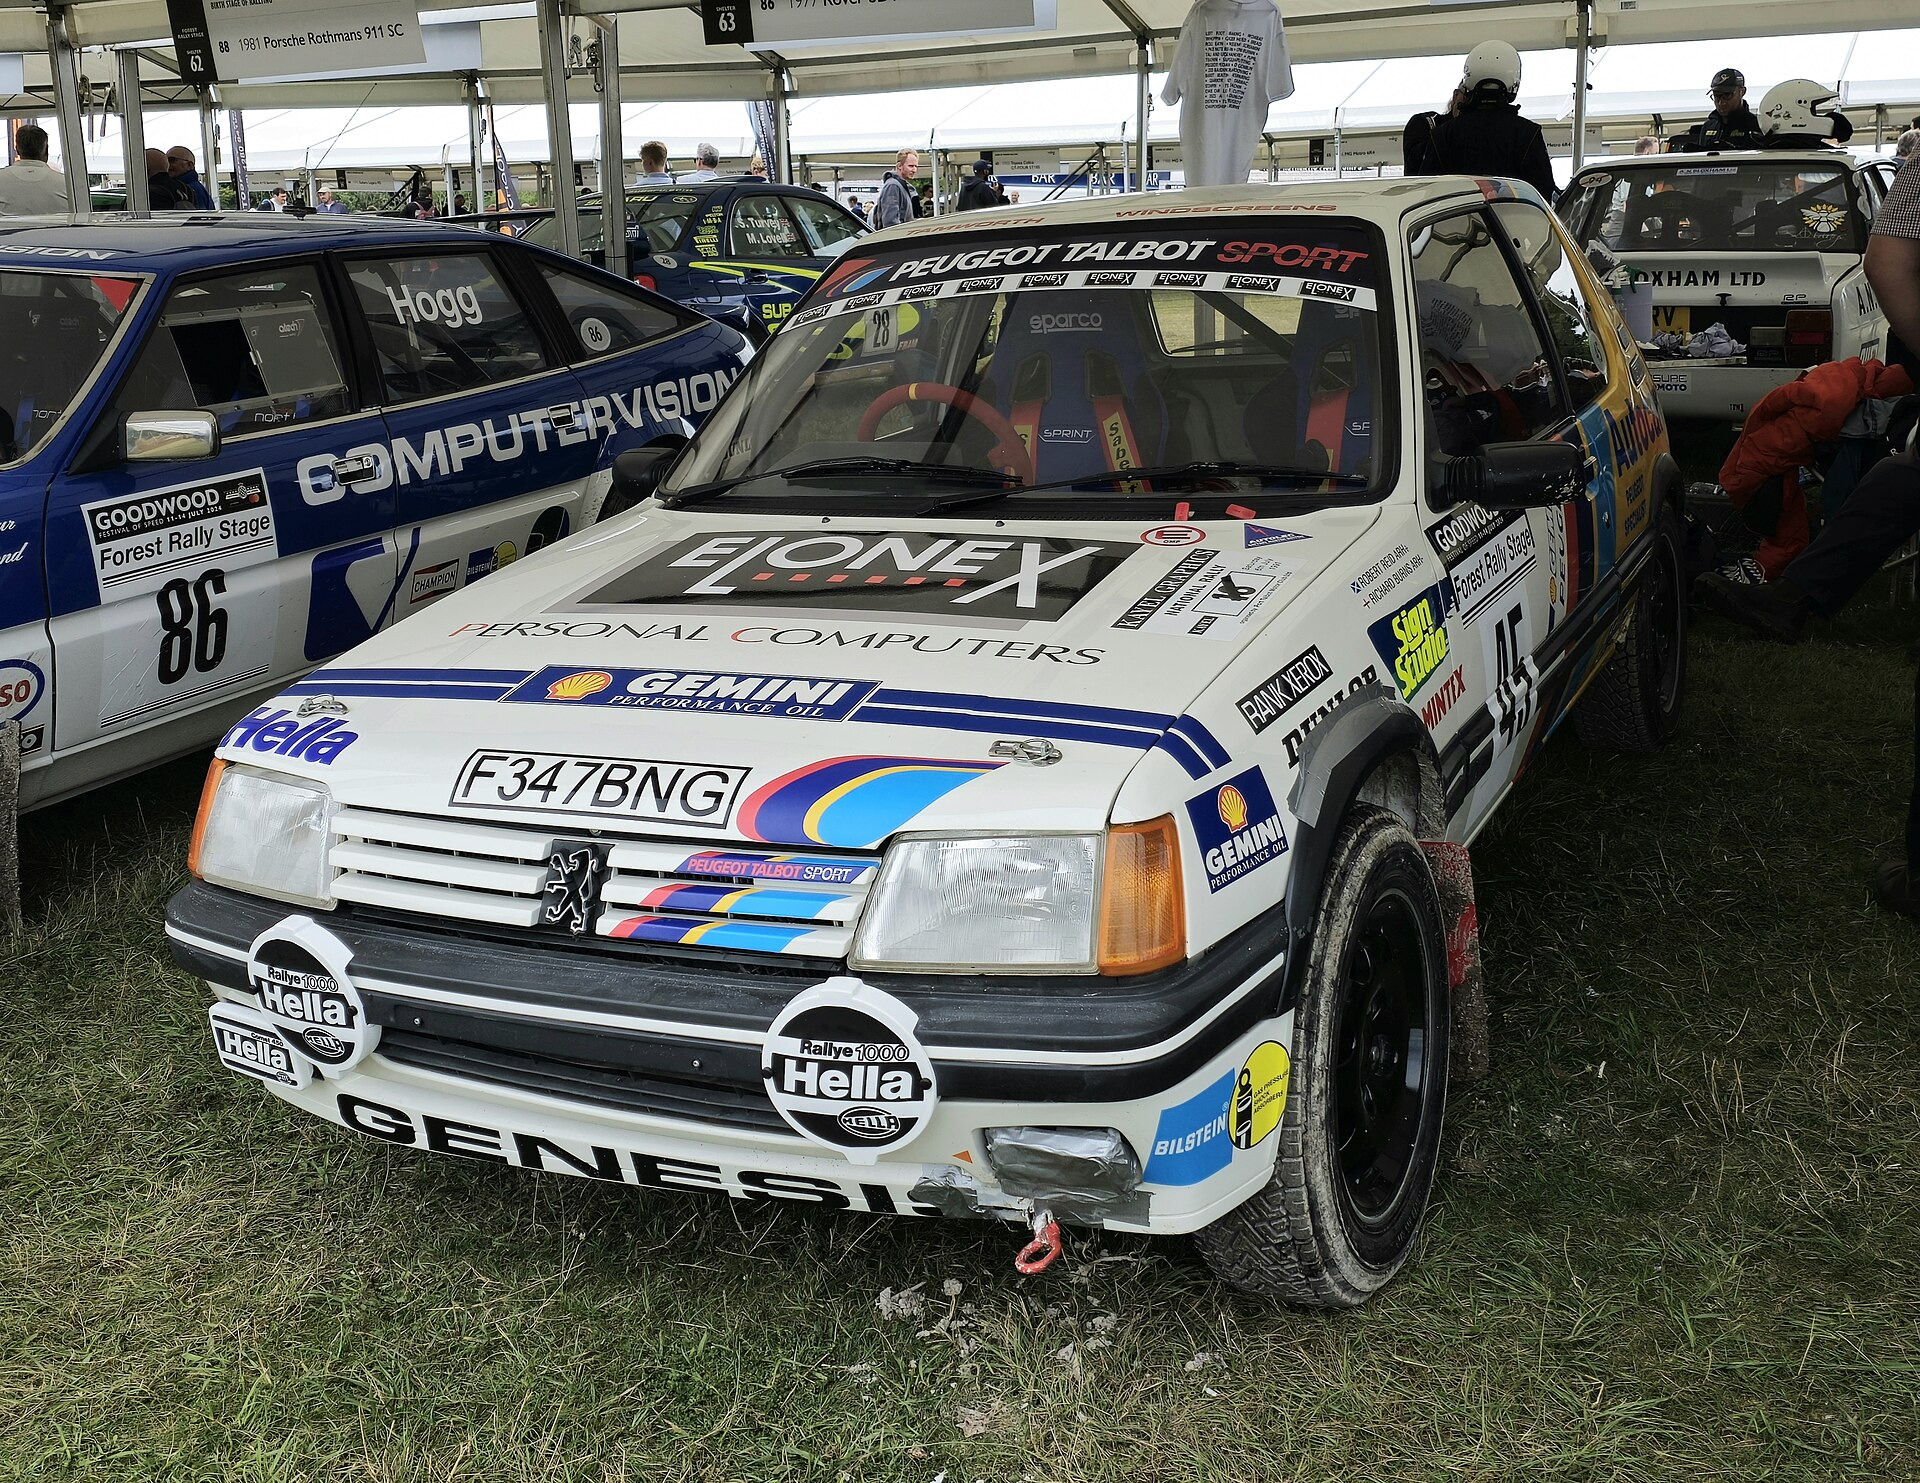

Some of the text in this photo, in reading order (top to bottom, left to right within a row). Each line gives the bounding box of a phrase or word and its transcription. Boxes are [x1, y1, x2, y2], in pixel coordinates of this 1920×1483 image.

[718, 13, 736, 32] 63
[218, 23, 404, 53] 88 1981 Porsche Rothmans 911 SC
[190, 55, 204, 72] 62
[1031, 173, 1056, 184] BAR
[1146, 173, 1159, 186] AR
[1115, 204, 1337, 218] WINDSCREENS
[906, 217, 1045, 236] TAMWORTH
[888, 240, 1369, 282] PEUGEOT TALBOT SPORT
[903, 283, 942, 299] ELONEX
[961, 278, 1000, 292] ELONEX
[1024, 274, 1066, 287] ELONEX
[1090, 272, 1134, 285] ELONEX
[1159, 272, 1206, 286] ELONEX
[1231, 275, 1278, 290] ELONEX
[1305, 282, 1353, 300] ELONEX
[1730, 271, 1767, 288] LTD
[386, 283, 484, 330] Hogg
[588, 323, 602, 344] 86
[872, 308, 890, 348] 28
[1029, 312, 1103, 334] sparco
[296, 366, 738, 507] COMPUTERVISION
[1043, 429, 1092, 438] SPRINT
[1109, 421, 1138, 494] Sabet
[95, 487, 220, 530] GOODWOOD
[98, 505, 222, 539] FESTIVAL OF SPEED 11-14 JULY 2024
[100, 515, 270, 570] Forest Rally Stage
[414, 569, 456, 593] CHAMPION
[466, 561, 491, 576] BILSTEIN
[669, 533, 1105, 609] ELONEX
[1357, 562, 1384, 589] ROBERT
[1379, 553, 1396, 572] REID
[1453, 528, 1531, 612] Forest Rally Stage
[1116, 549, 1216, 630] KAYEL GRAPHICS
[1164, 563, 1227, 617] NATIONAL RALLY
[1368, 577, 1396, 605] RICHARD
[1394, 563, 1412, 585] BURNS
[155, 567, 229, 685] 86
[1191, 617, 1215, 635] KAYEL
[1391, 598, 1434, 657] Sign
[447, 621, 1107, 666] PERSONAL COMPUTERS
[1394, 626, 1448, 700] Studio
[624, 669, 854, 706] GEMINI
[1240, 649, 1330, 729] RANK XEROX
[606, 694, 827, 718] PERFORMANCE OIL
[218, 705, 360, 767] Hella
[466, 755, 735, 819] F347BNG
[1205, 814, 1284, 876] GEMINI
[687, 857, 853, 882] PEUGEOT TALBOT SPORT
[1210, 840, 1287, 889] PERFORMANCE OIL
[267, 966, 339, 993] Rallye 1000
[261, 980, 348, 1026] Hella
[222, 1029, 288, 1071] Hella
[250, 1032, 270, 1044] Comet
[304, 1032, 344, 1053] HELLA
[799, 1038, 910, 1062] Rallye 1000
[783, 1057, 913, 1101] Hella
[1253, 1068, 1290, 1098] GAS PRESSURE
[1253, 1090, 1270, 1107] SHOCK
[1253, 1089, 1284, 1115] ABSORBERS
[841, 1114, 901, 1131] HELLA
[1154, 1111, 1228, 1156] BILSTEIN
